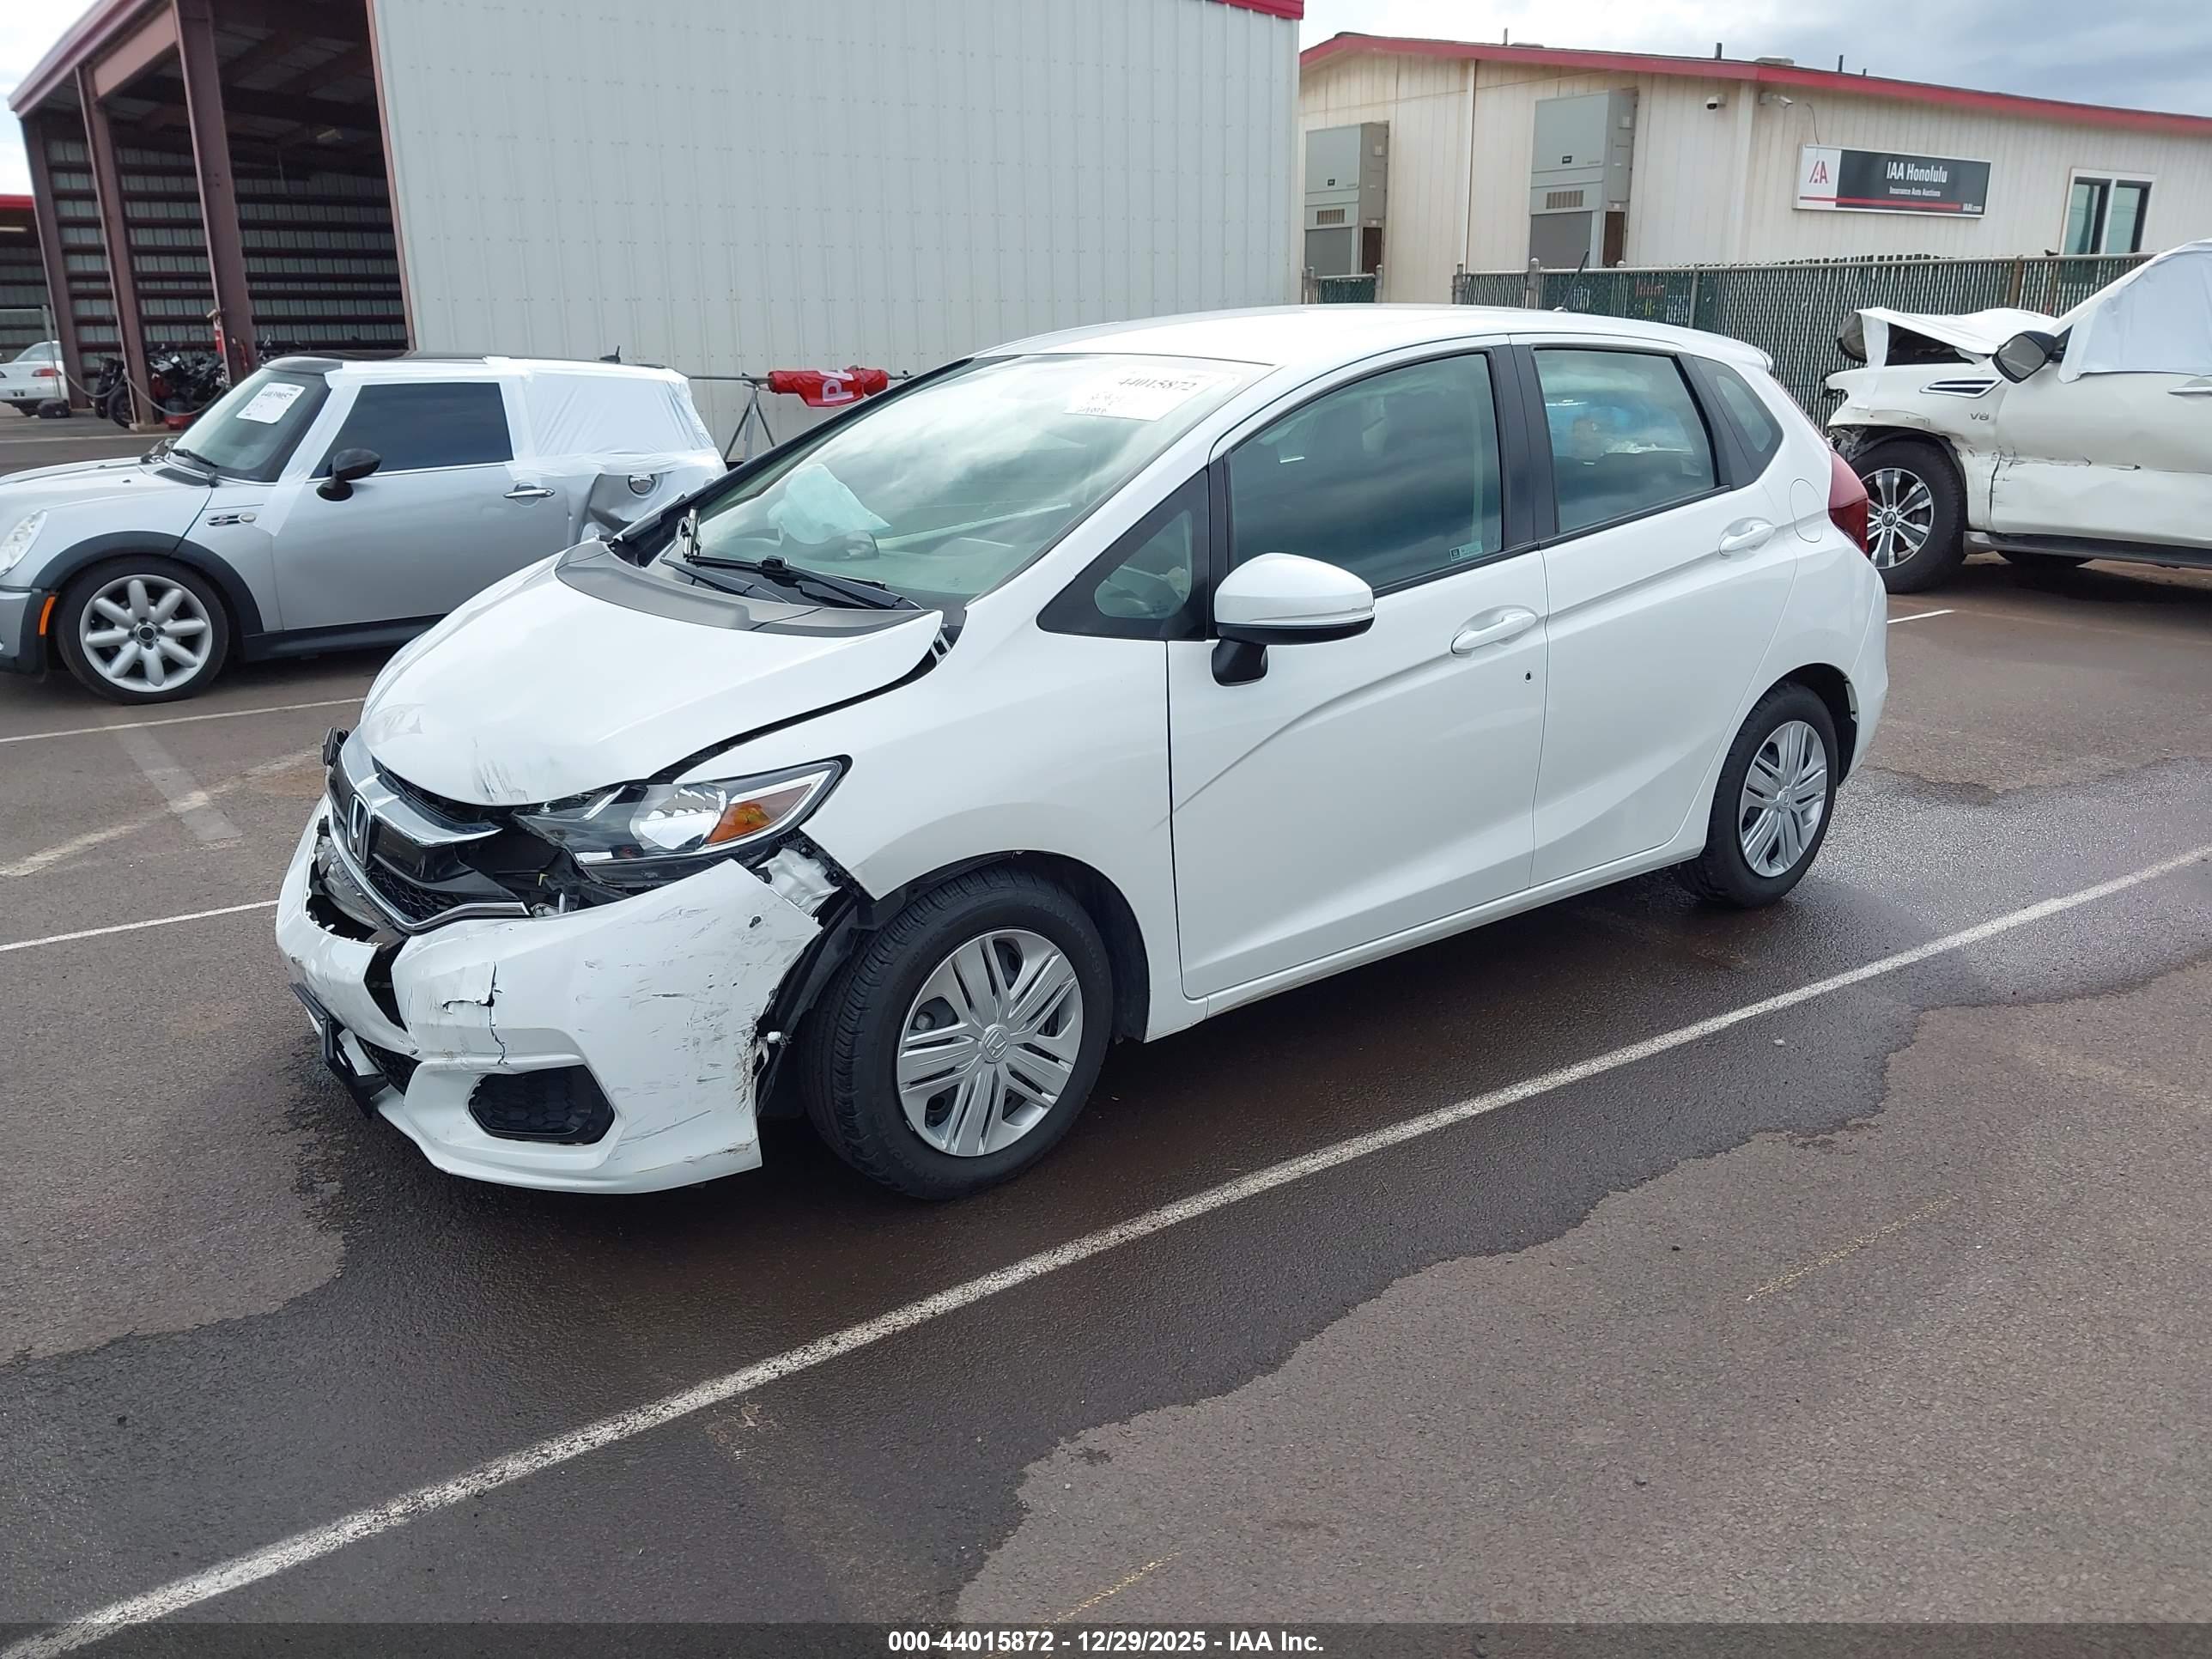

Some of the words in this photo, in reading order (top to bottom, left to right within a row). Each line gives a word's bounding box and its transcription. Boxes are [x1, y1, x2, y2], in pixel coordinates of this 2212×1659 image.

[1887, 161, 1904, 180] IAA
[1906, 163, 1948, 184] Honolulu
[1118, 377, 1198, 392] 44015872
